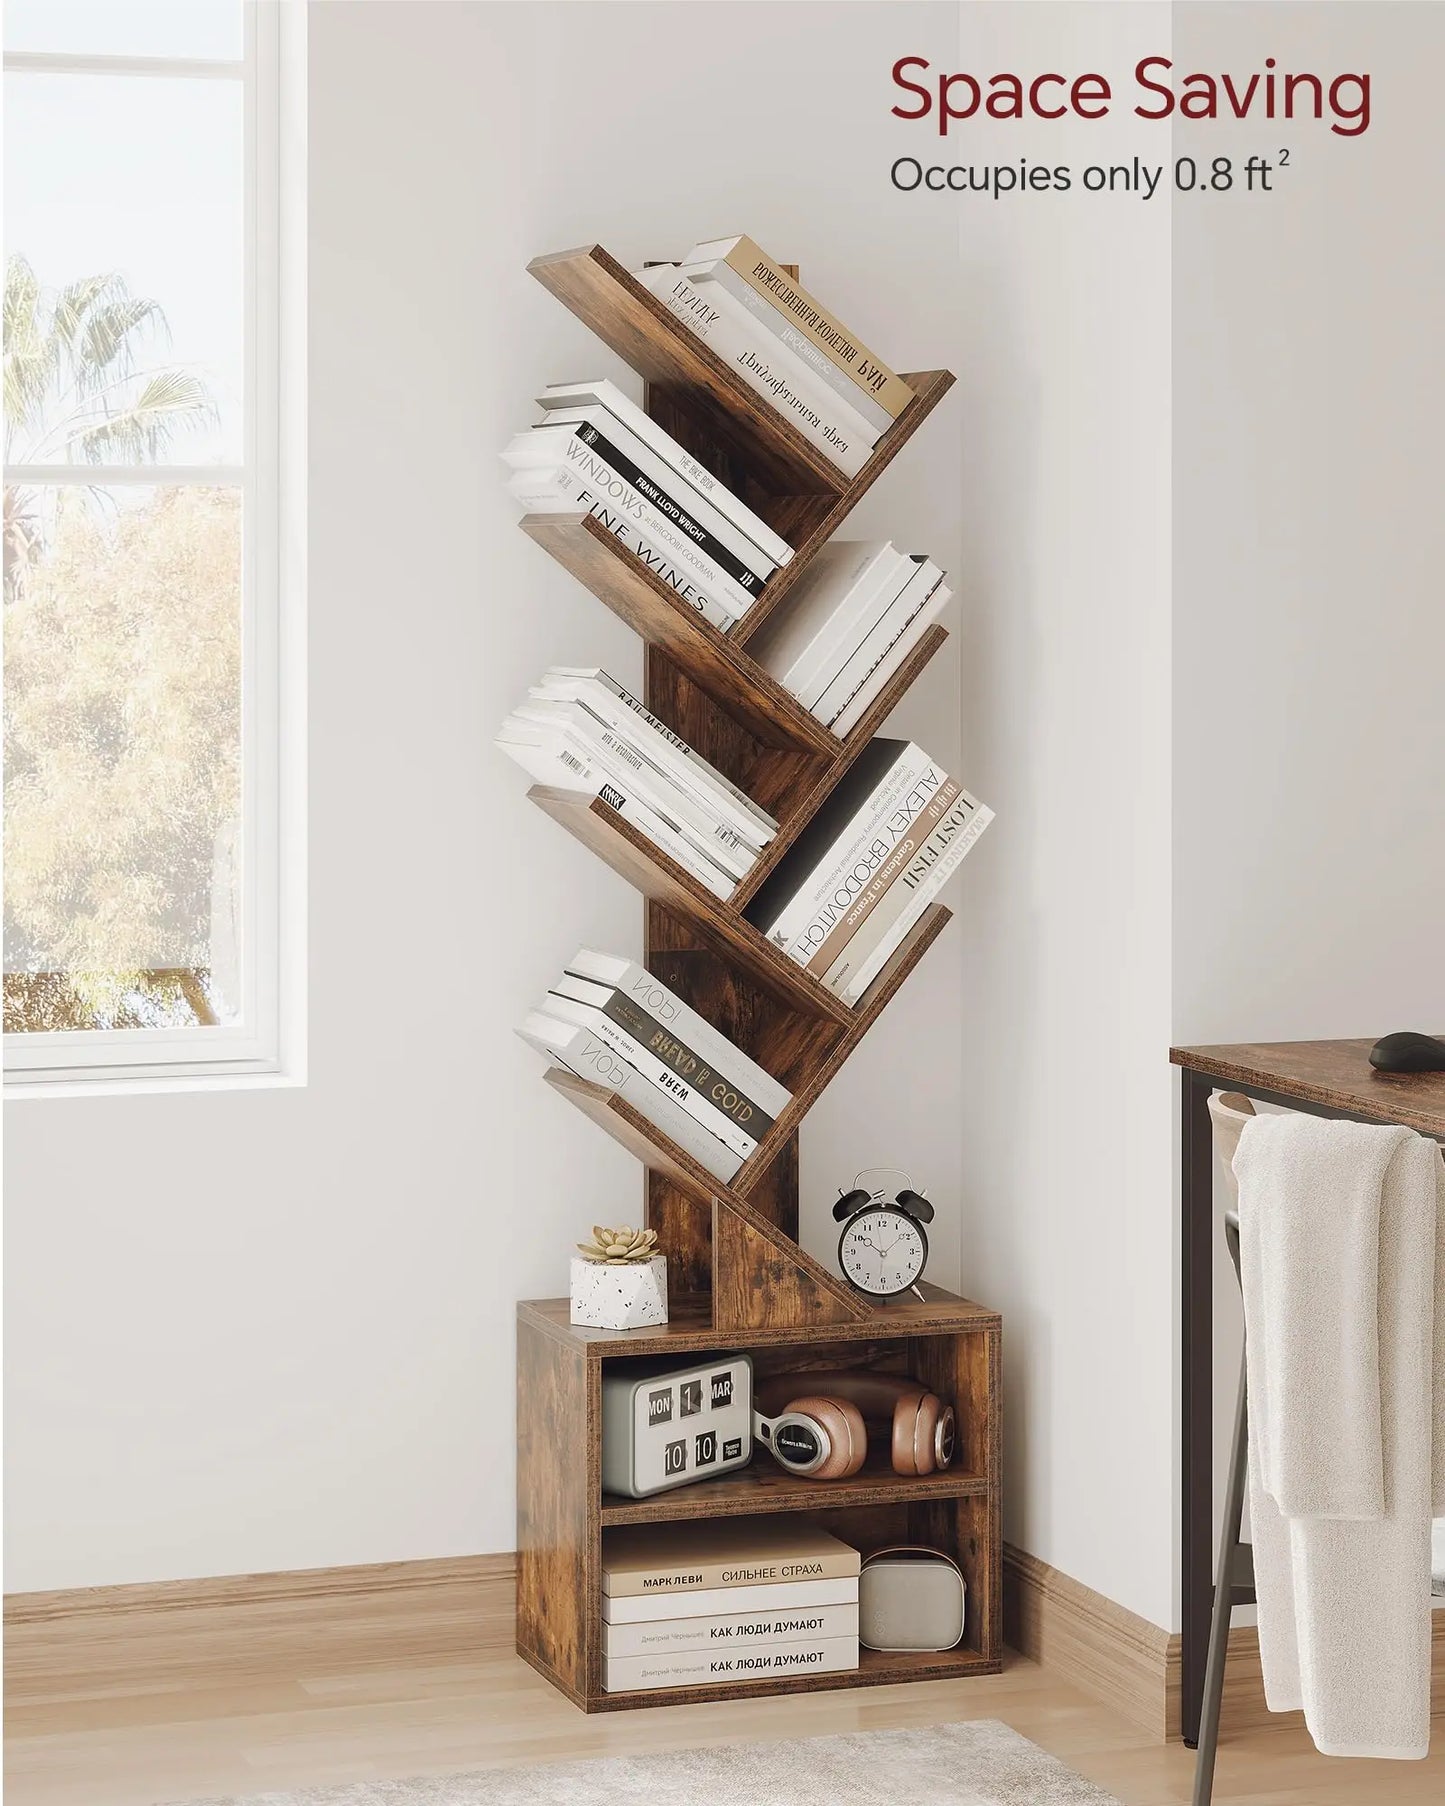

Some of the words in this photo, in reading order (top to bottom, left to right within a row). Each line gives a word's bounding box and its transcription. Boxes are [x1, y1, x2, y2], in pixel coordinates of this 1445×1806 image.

[566, 439, 647, 520] WINDOWS
[679, 455, 694, 473] THE
[699, 472, 716, 492] BOOK
[636, 477, 660, 501] FRANK
[656, 494, 680, 518] LLOYD
[677, 511, 706, 543] WRIGHT
[576, 490, 630, 541] FINE
[636, 541, 709, 611] WINES
[886, 768, 940, 842] ALEXEY
[936, 798, 974, 848] LOST
[880, 839, 915, 880] Gardens
[903, 845, 939, 889] FISH
[797, 838, 890, 957] BRODOVITCH
[872, 880, 886, 892] in
[847, 890, 877, 926] France
[878, 1220, 887, 1228] 12
[649, 1397, 670, 1416] MON
[684, 1386, 691, 1411] 1
[711, 1380, 731, 1400] MAR
[664, 1445, 682, 1470] 10
[695, 1436, 712, 1462] 10
[643, 1577, 672, 1588] МАРК
[673, 1574, 703, 1585] ЛЕВИ
[721, 1567, 777, 1582] СИЛЬНЕЕ
[781, 1563, 823, 1577] СТРАХА
[710, 1627, 733, 1639] КАК
[735, 1624, 771, 1637] ЛЮДИ
[773, 1618, 824, 1633] ДУМАЮТ
[710, 1660, 733, 1672] КАК
[735, 1657, 771, 1670] ЛЮДИ
[773, 1652, 824, 1666] ДУМАЮТ
